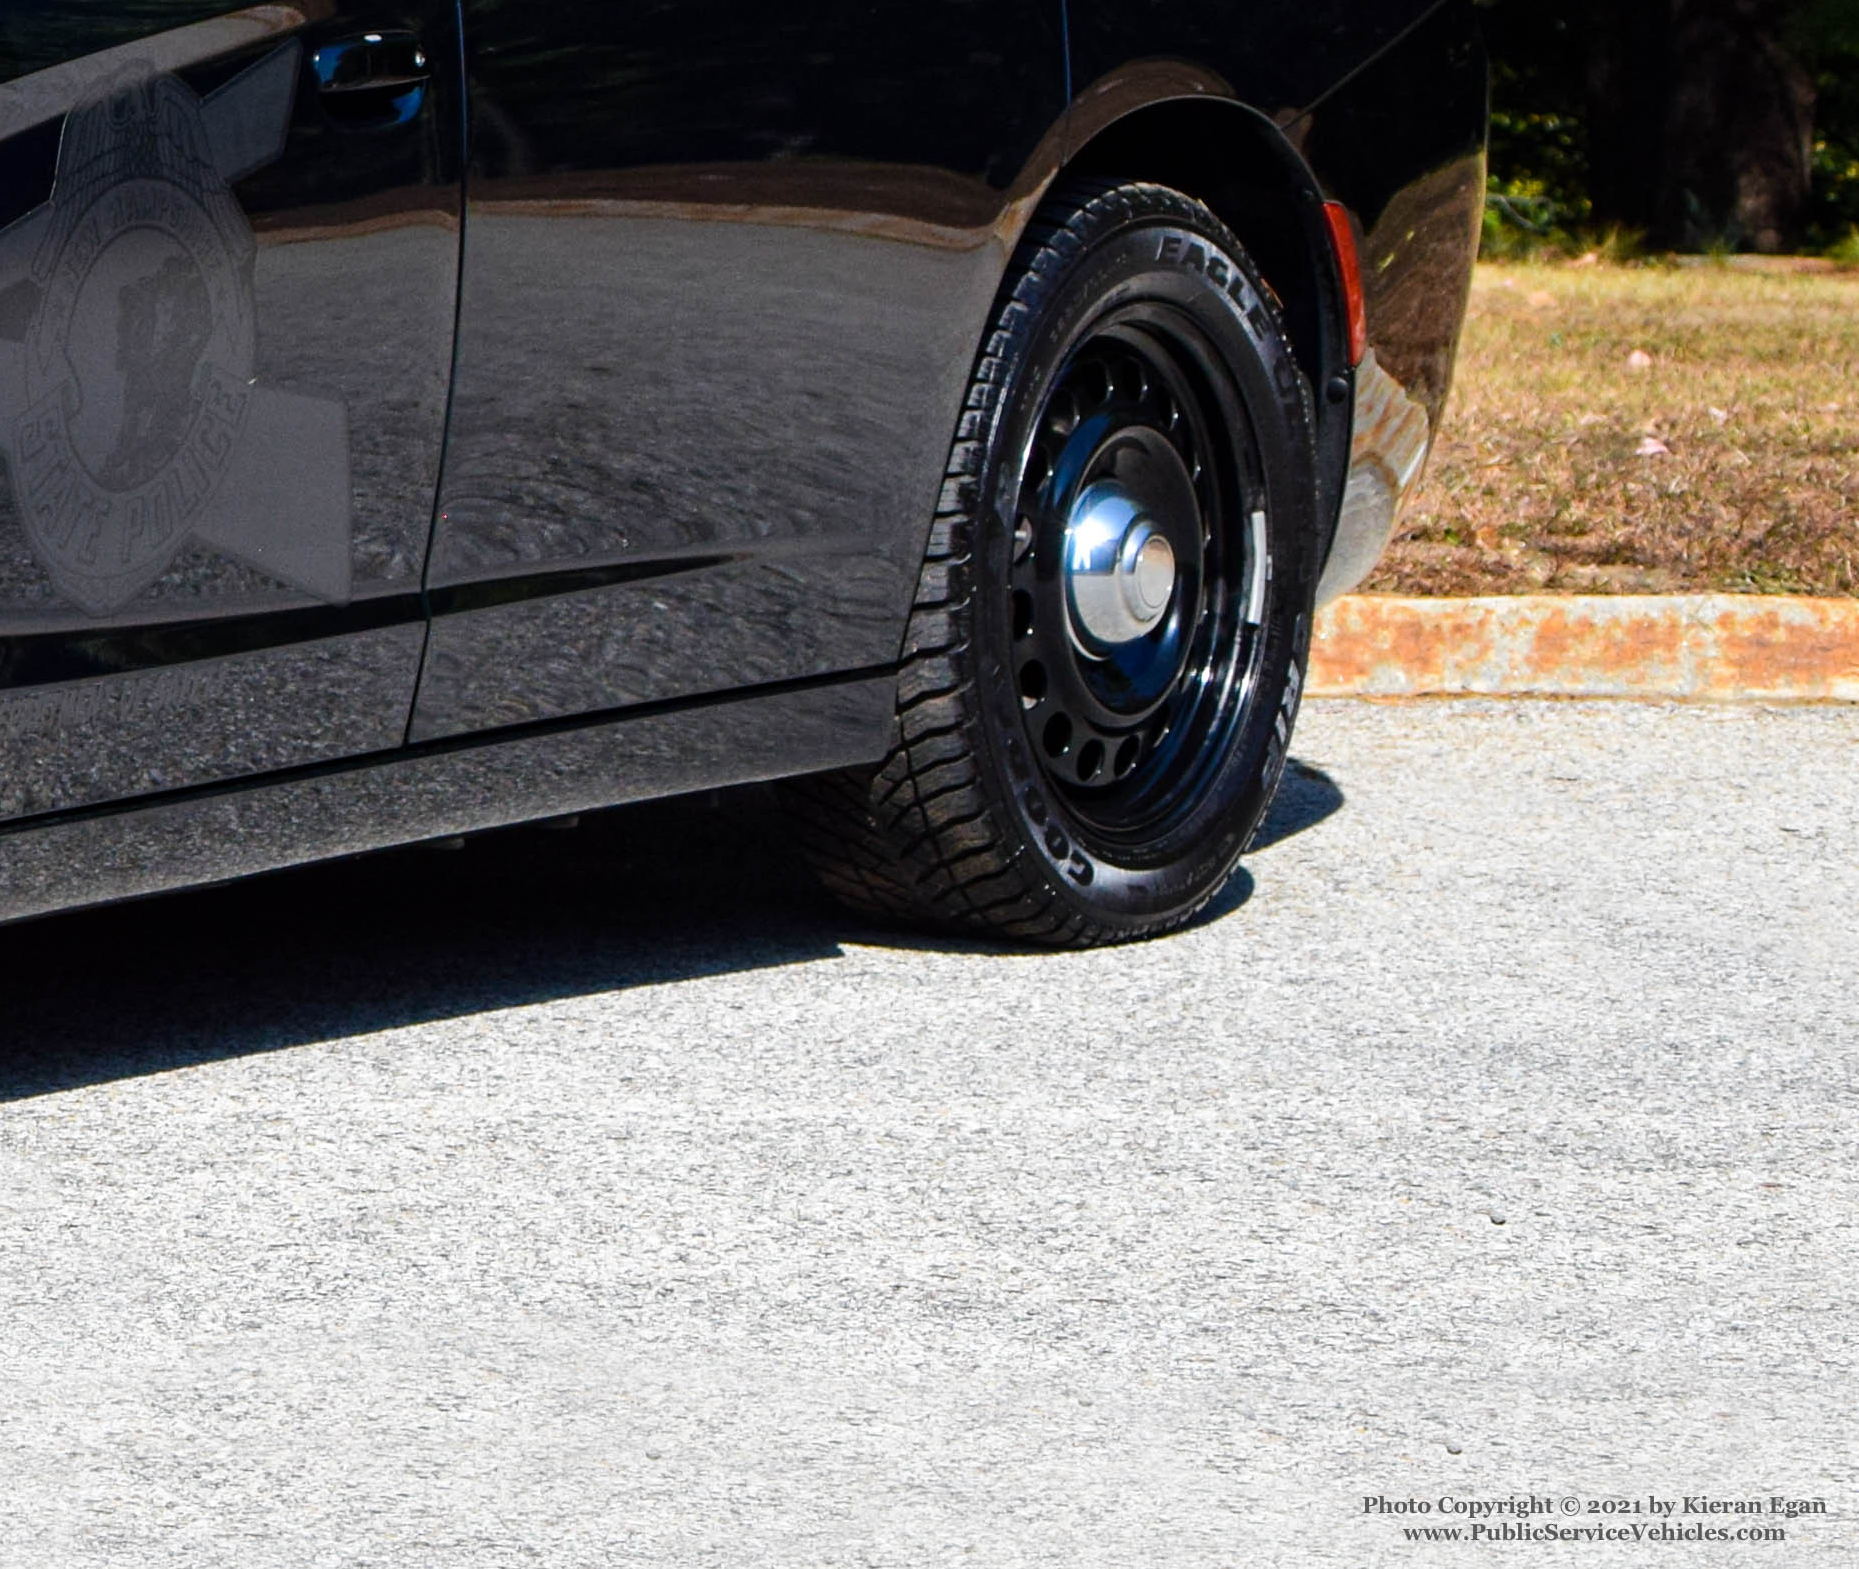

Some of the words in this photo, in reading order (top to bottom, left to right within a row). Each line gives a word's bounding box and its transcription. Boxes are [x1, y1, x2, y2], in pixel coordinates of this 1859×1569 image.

[1156, 237, 1273, 340] EAGLE
[19, 410, 113, 565] STATE
[121, 378, 248, 564] POLICE
